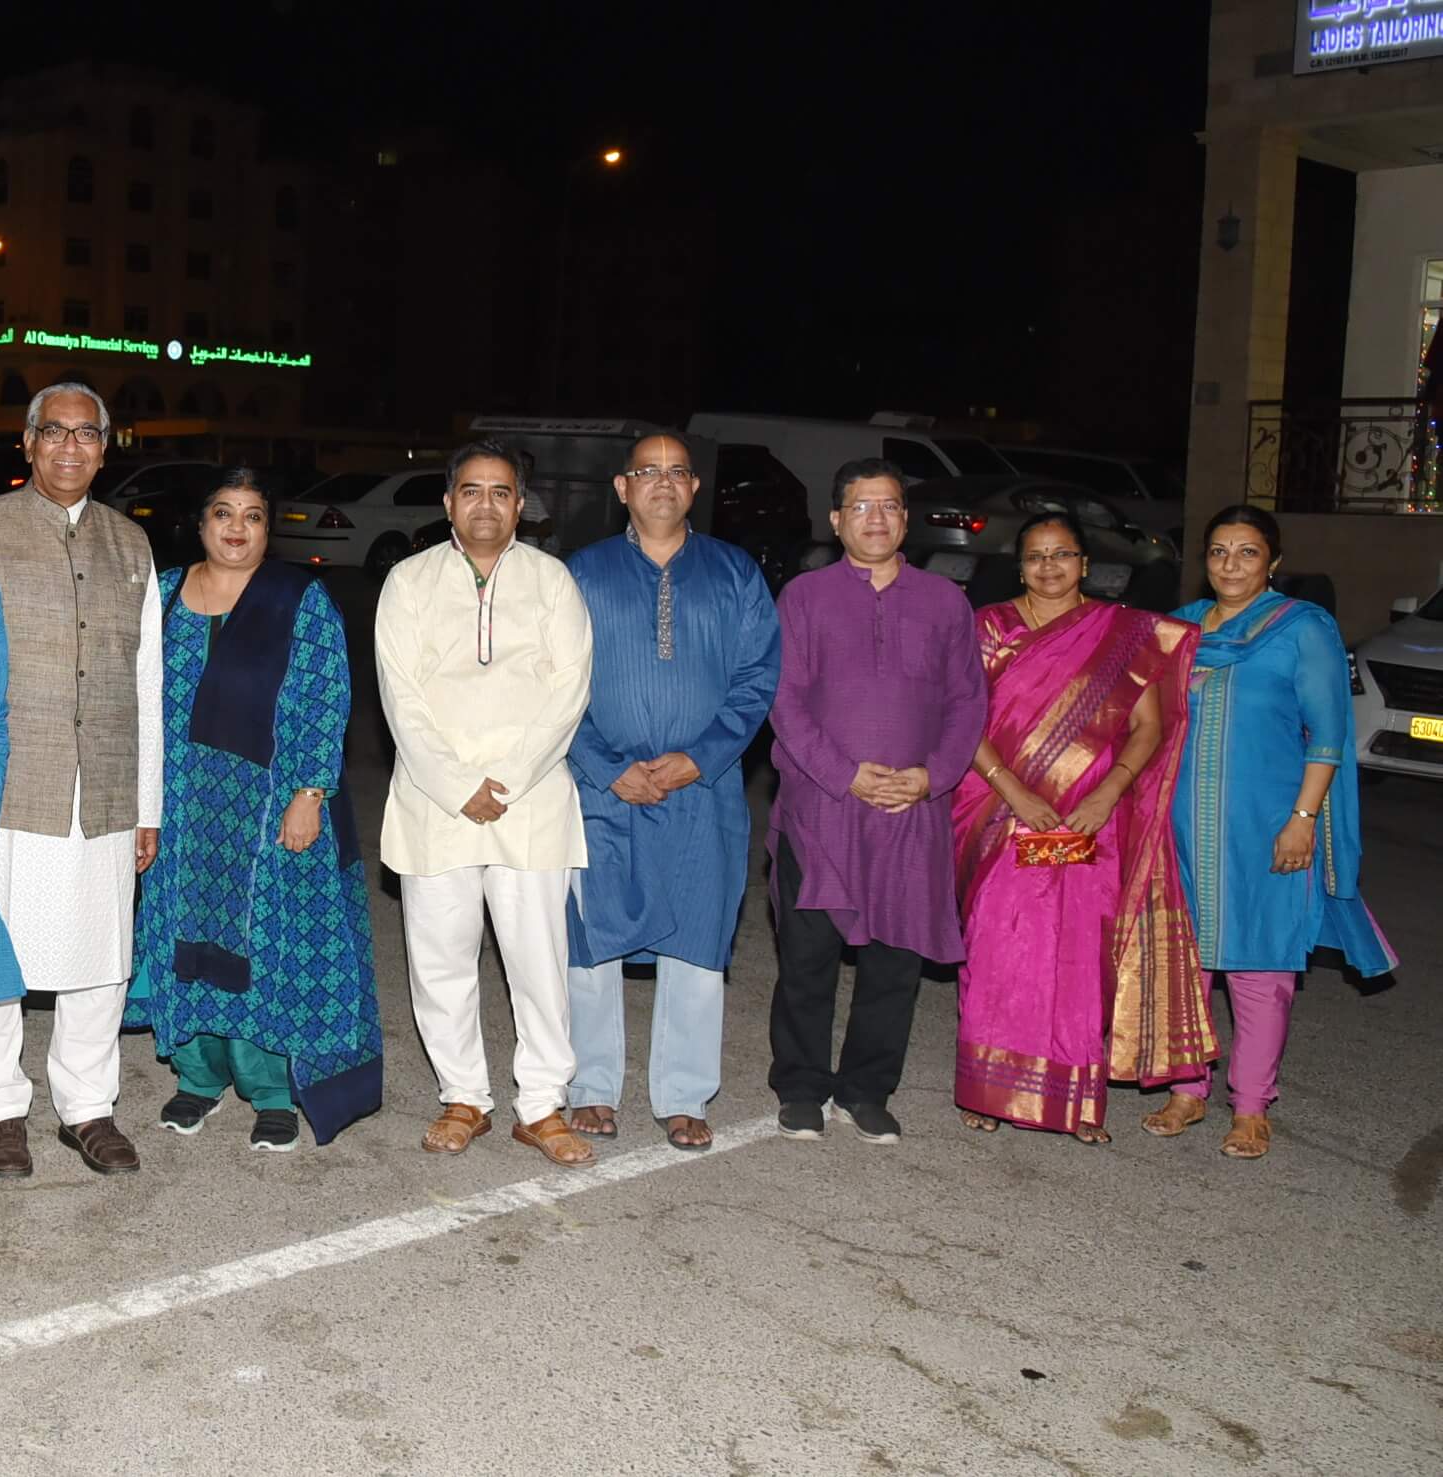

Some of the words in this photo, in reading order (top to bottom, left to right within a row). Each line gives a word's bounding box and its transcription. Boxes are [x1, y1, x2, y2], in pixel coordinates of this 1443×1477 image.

[1310, 23, 1363, 55] LADIES
[24, 330, 36, 344] Al
[38, 331, 79, 349] Omaniya
[81, 335, 122, 352] Financial
[123, 340, 159, 354] Services
